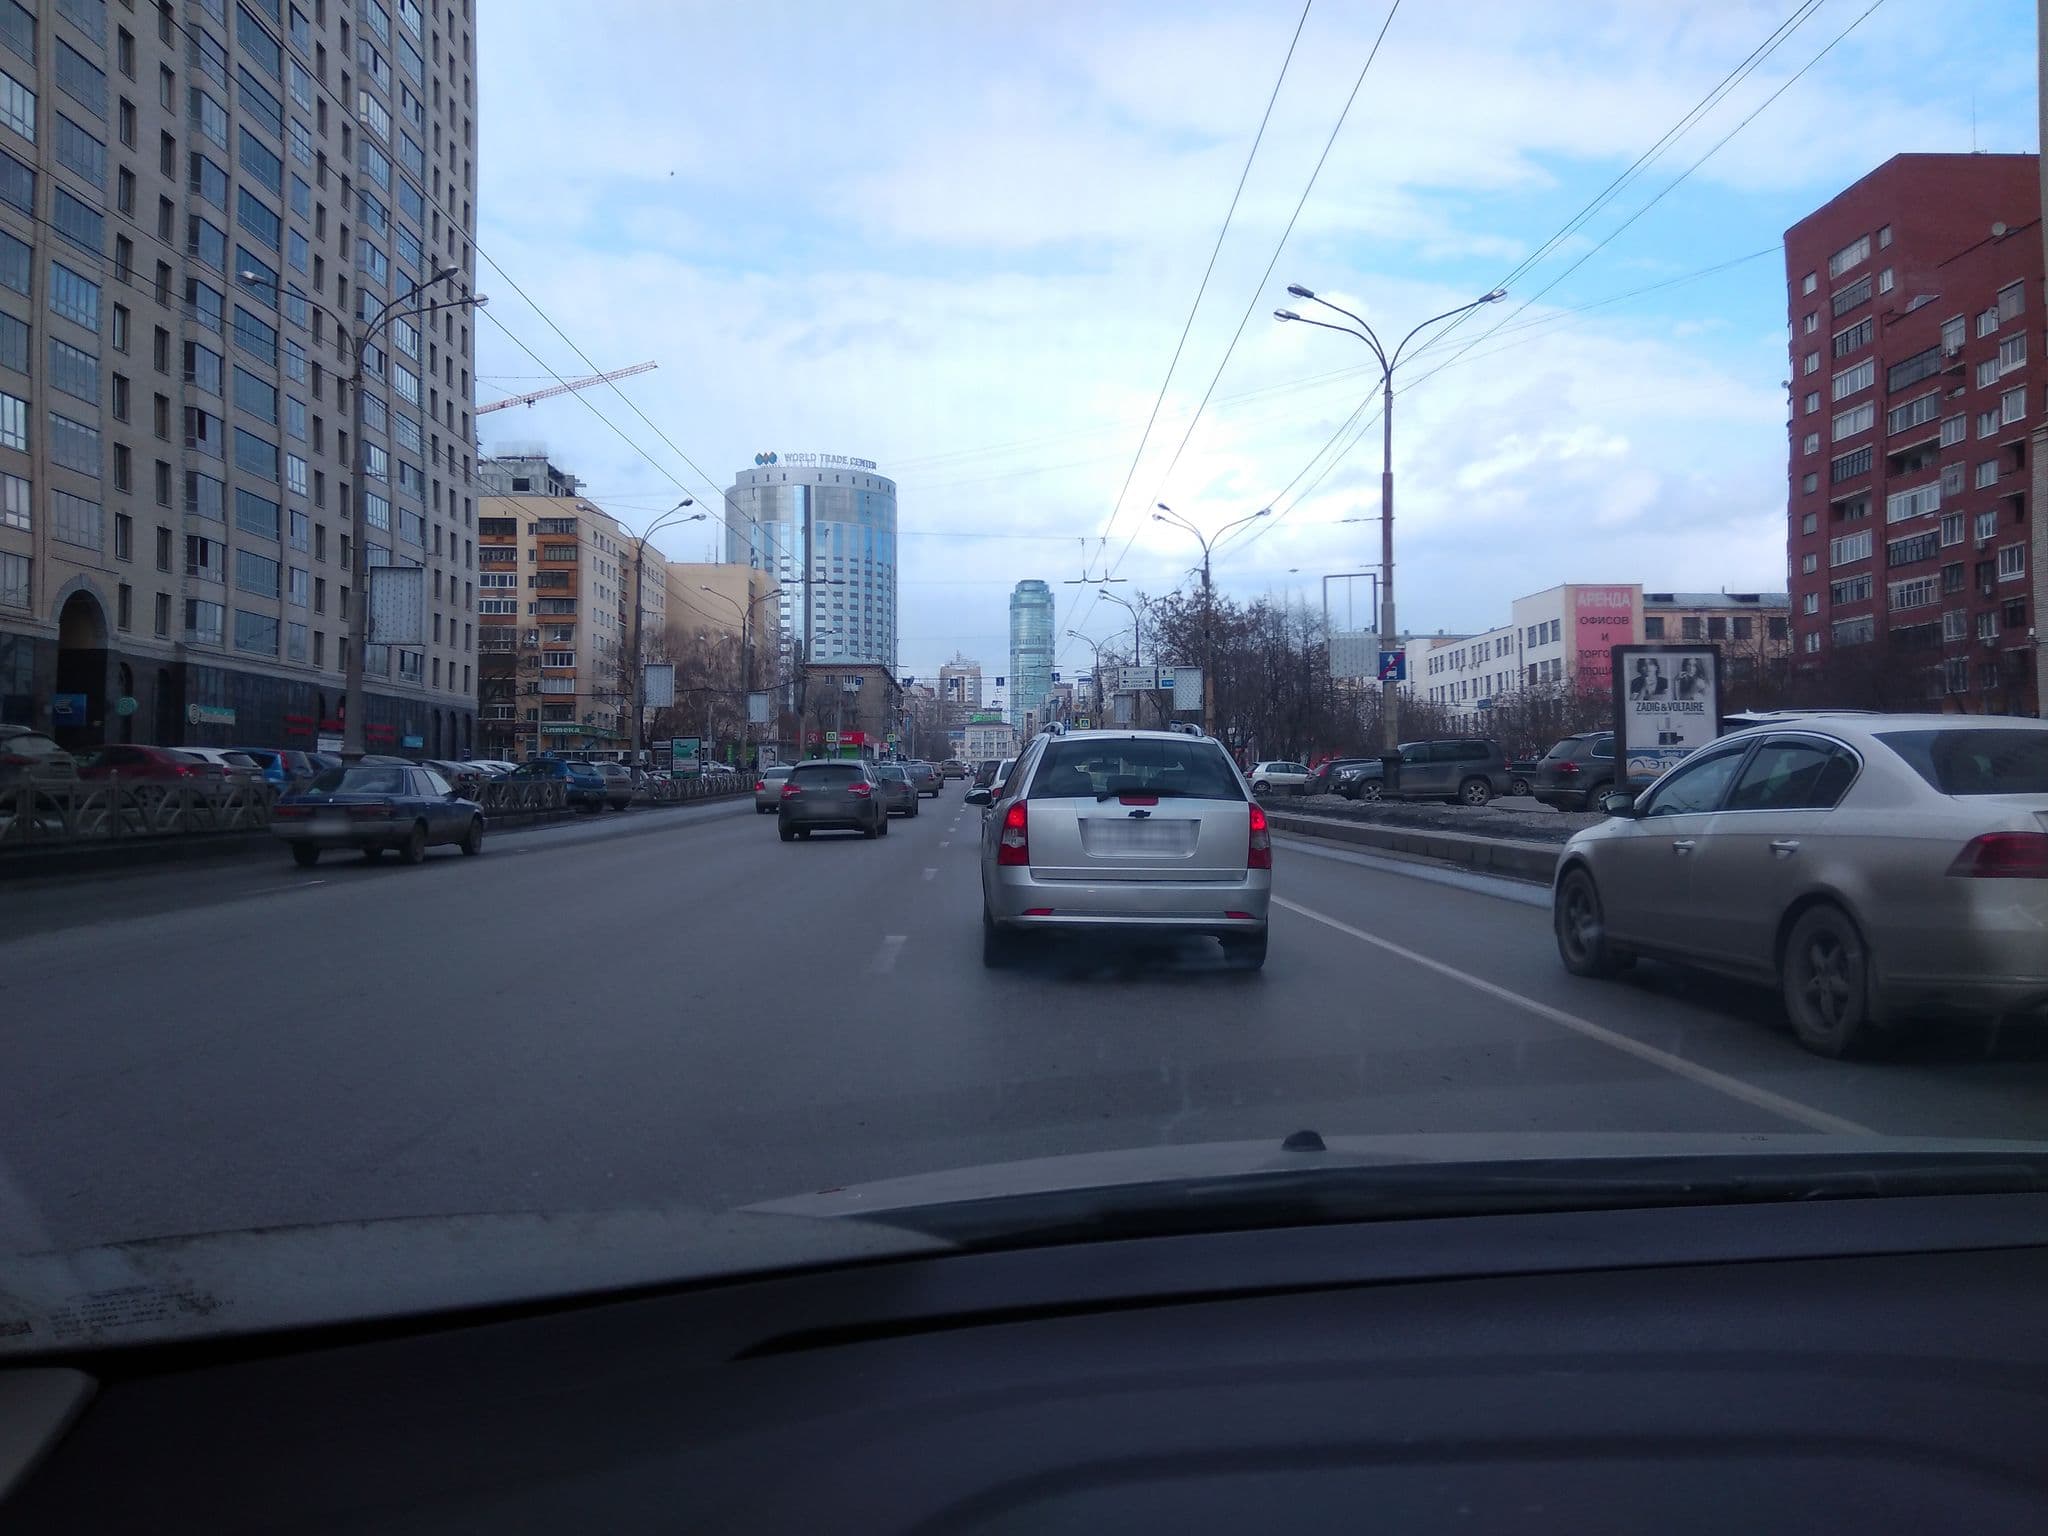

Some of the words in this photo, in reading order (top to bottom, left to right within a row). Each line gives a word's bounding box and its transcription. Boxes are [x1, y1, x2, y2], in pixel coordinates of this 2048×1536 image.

[784, 452, 816, 463] WORLD
[819, 453, 848, 465] TRADE
[849, 457, 877, 469] CENTER
[1577, 591, 1631, 608] АРЕНДА
[1580, 616, 1629, 625] ОФИСОВ
[1601, 632, 1609, 641] И
[1636, 701, 1660, 712] ZADIG
[1667, 701, 1705, 712] VOLTAIRE
